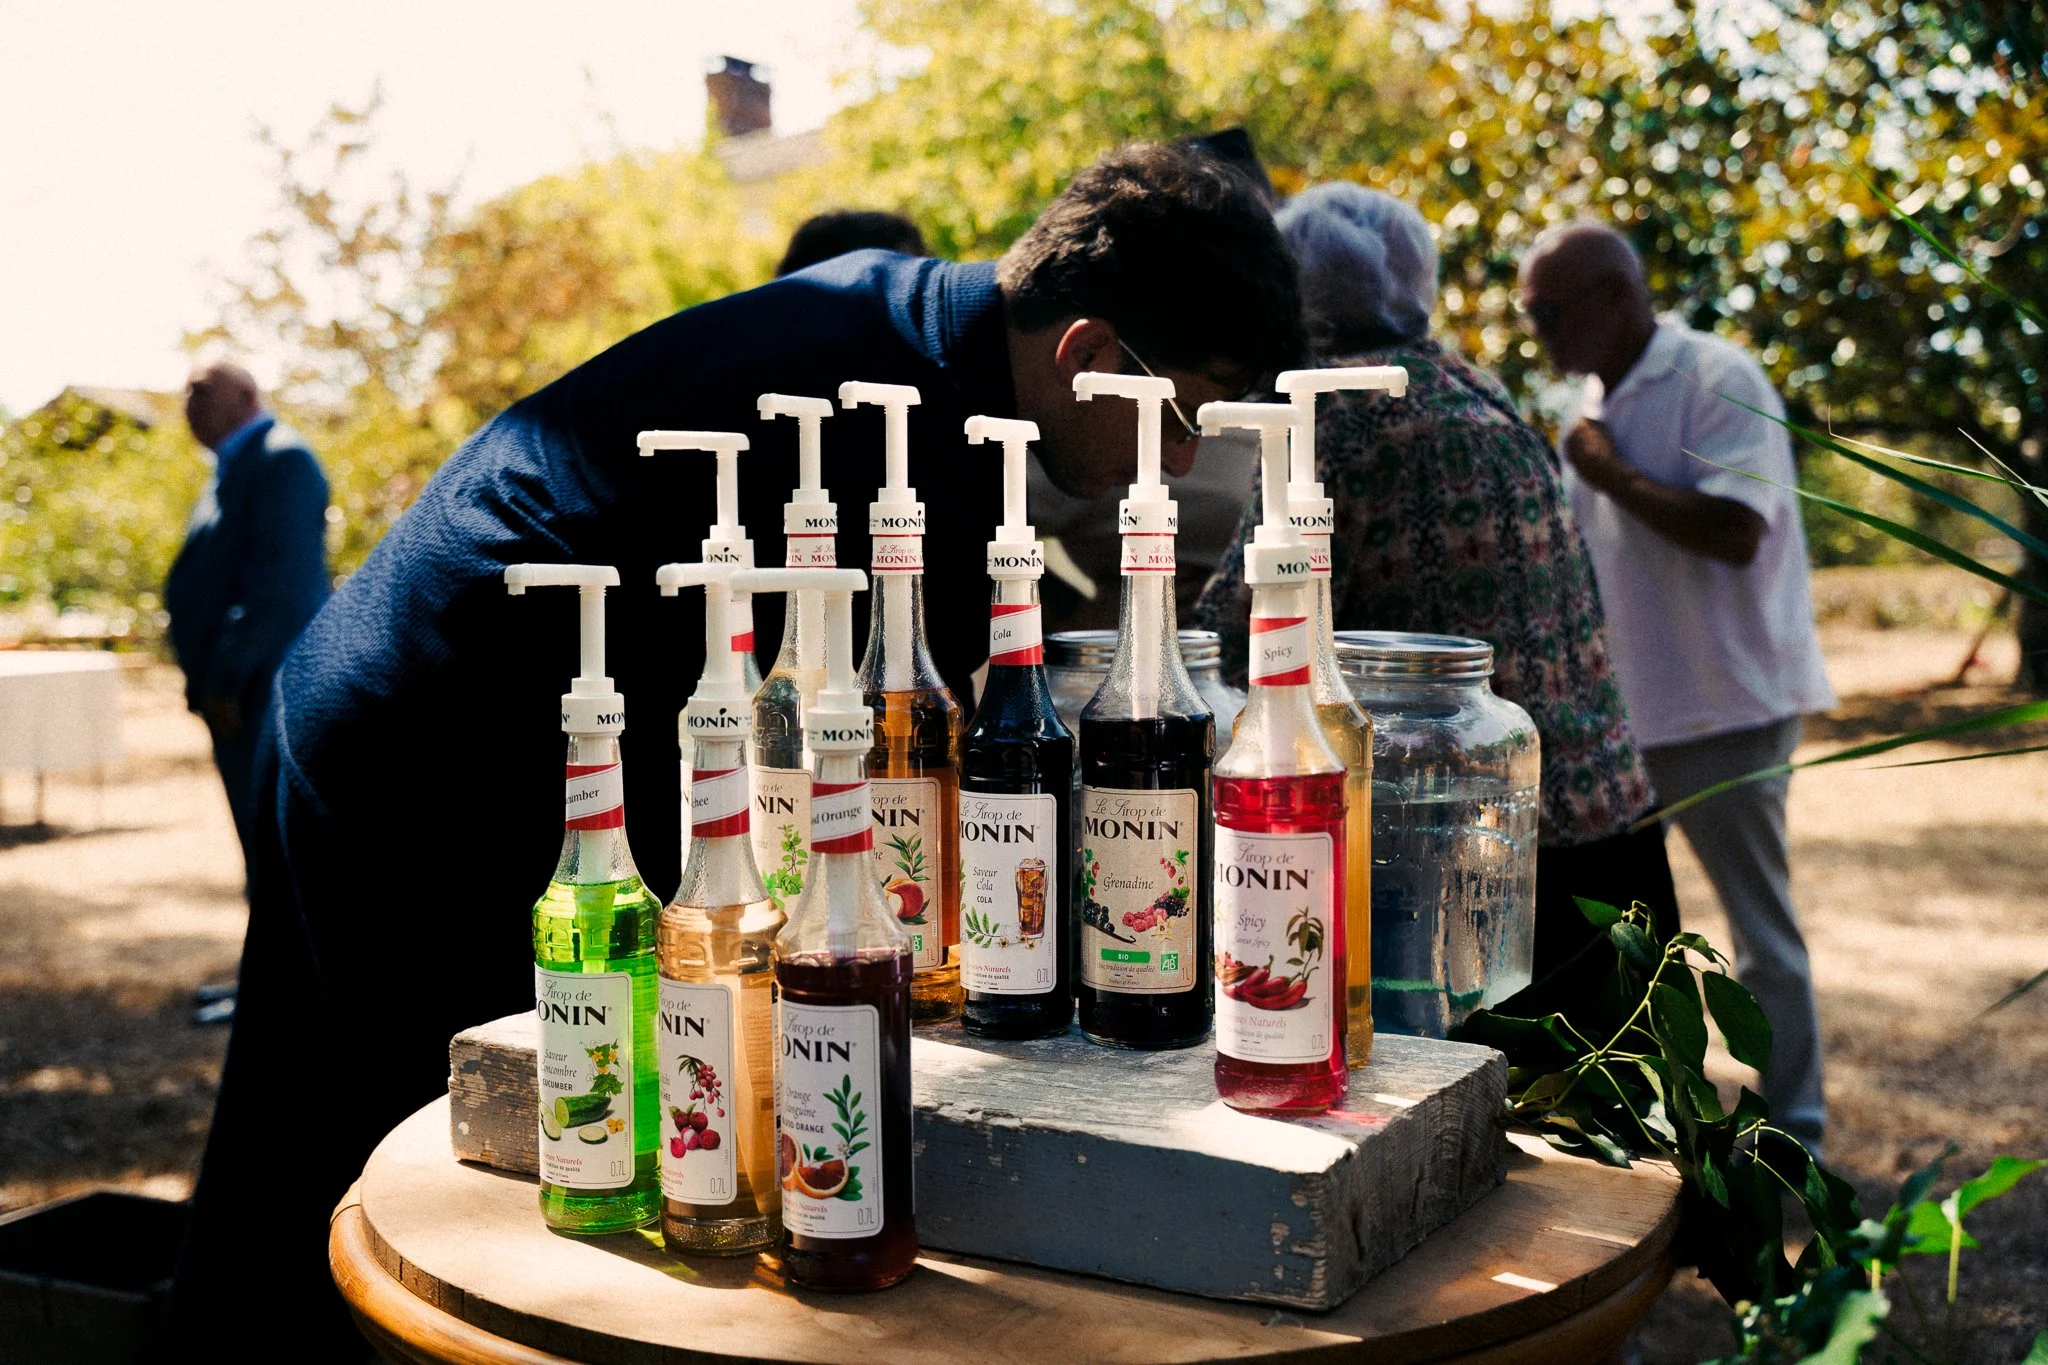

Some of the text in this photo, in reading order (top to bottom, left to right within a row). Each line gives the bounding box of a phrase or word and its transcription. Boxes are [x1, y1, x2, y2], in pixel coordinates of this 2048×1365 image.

[876, 555, 917, 564] MONIN
[993, 628, 1011, 641] Cola
[1264, 646, 1293, 661] Spicy
[892, 795, 908, 805] de
[821, 806, 862, 823] Orange
[971, 802, 1003, 825] Sirop
[1006, 810, 1022, 821] de
[1092, 798, 1167, 822] Le Sirop de
[1084, 815, 1179, 841] MONIN
[1235, 843, 1295, 869] Sirop de
[973, 866, 998, 878] Saveur
[976, 877, 993, 891] Cola
[1103, 872, 1154, 892] Grenadine
[976, 895, 993, 904] COLA
[1234, 908, 1266, 933] Spicy
[1118, 953, 1130, 961] BIO
[983, 965, 1012, 974] Naturels
[1128, 964, 1136, 972] de
[542, 979, 592, 1005] Sirop de
[677, 999, 691, 1011] de
[785, 1012, 836, 1039] Sirop de
[1249, 1016, 1288, 1028] Naturels
[543, 1048, 568, 1062] Saveur
[795, 1121, 825, 1134] ORANGE
[555, 1154, 583, 1165] Naturels
[610, 1160, 627, 1178] 0.7L
